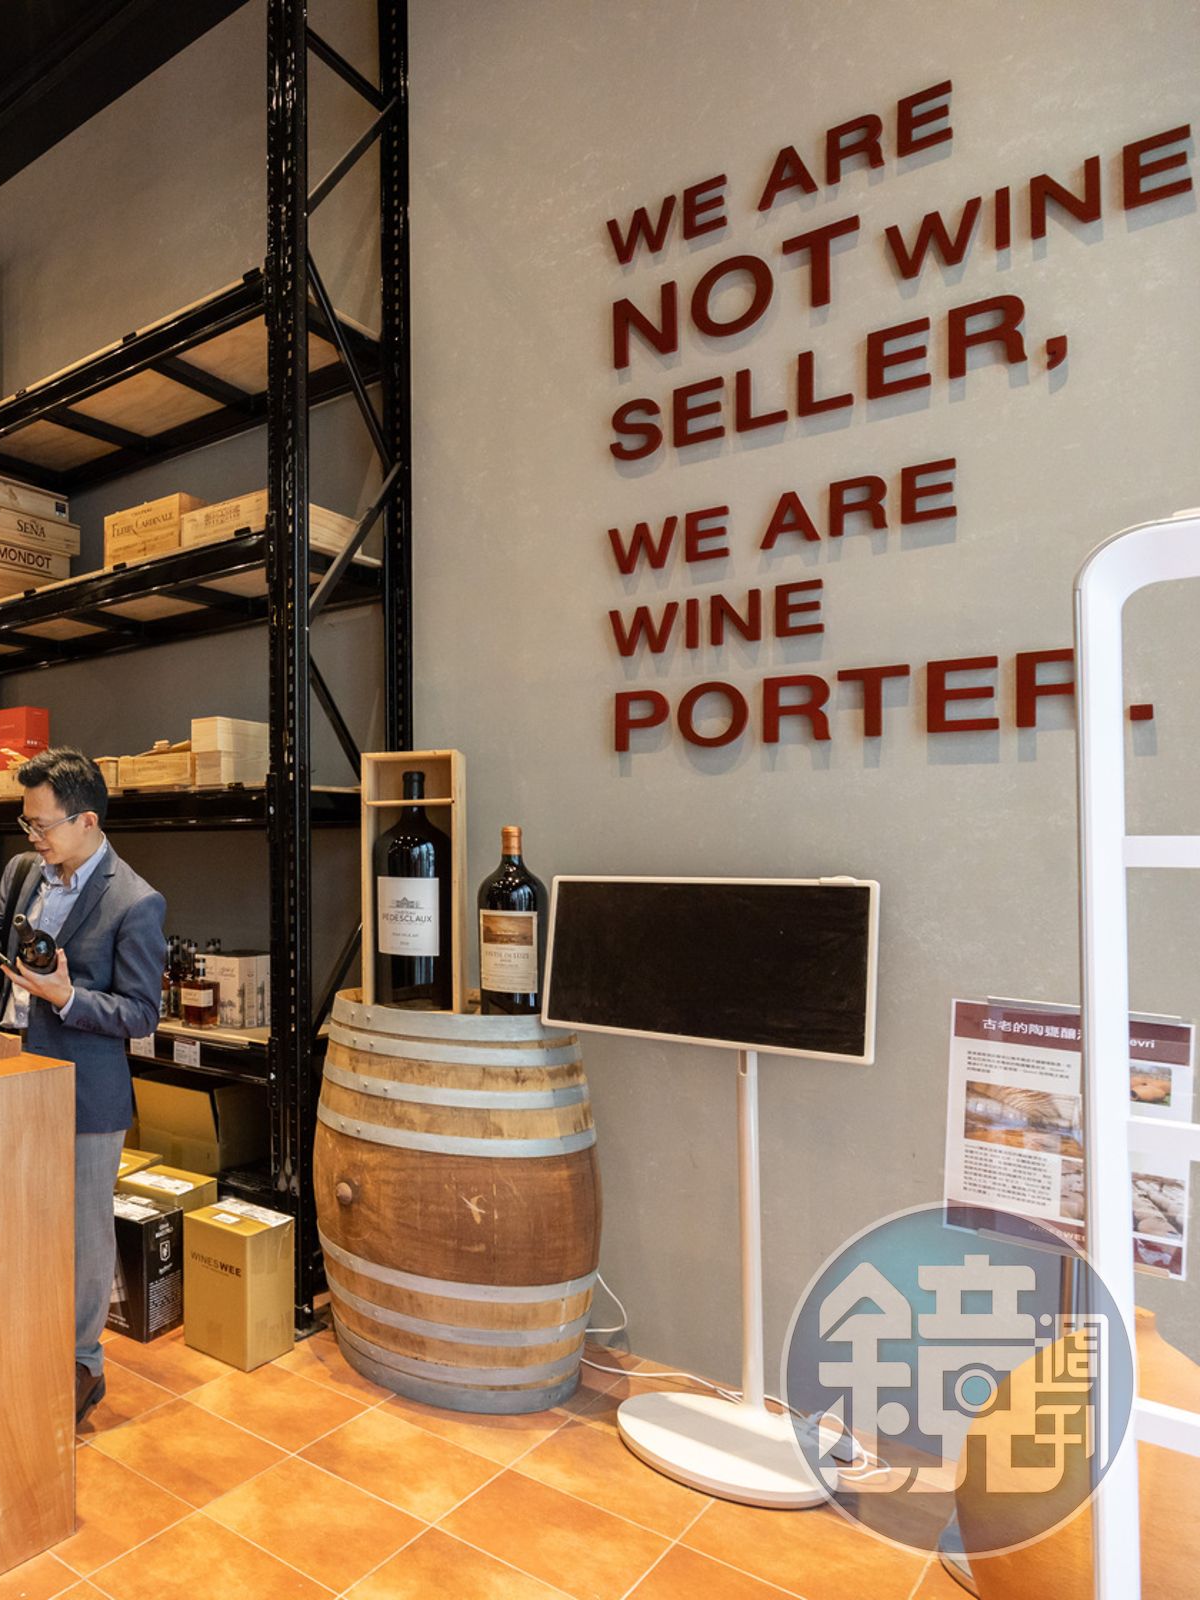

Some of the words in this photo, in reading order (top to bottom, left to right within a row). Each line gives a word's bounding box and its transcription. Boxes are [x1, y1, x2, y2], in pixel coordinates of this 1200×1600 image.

[607, 173, 727, 264] WE
[758, 80, 953, 212] ARE
[613, 215, 860, 370] NOT
[885, 124, 1193, 280] WINE
[610, 294, 1067, 460] SELLER,
[16, 519, 47, 539] SEÑA
[608, 505, 730, 575] WE
[759, 458, 957, 550] ARE
[609, 579, 825, 657] WINE
[983, 1017, 1081, 1041] 古老的陶甕釀
[190, 1251, 242, 1278] WINESWEE
